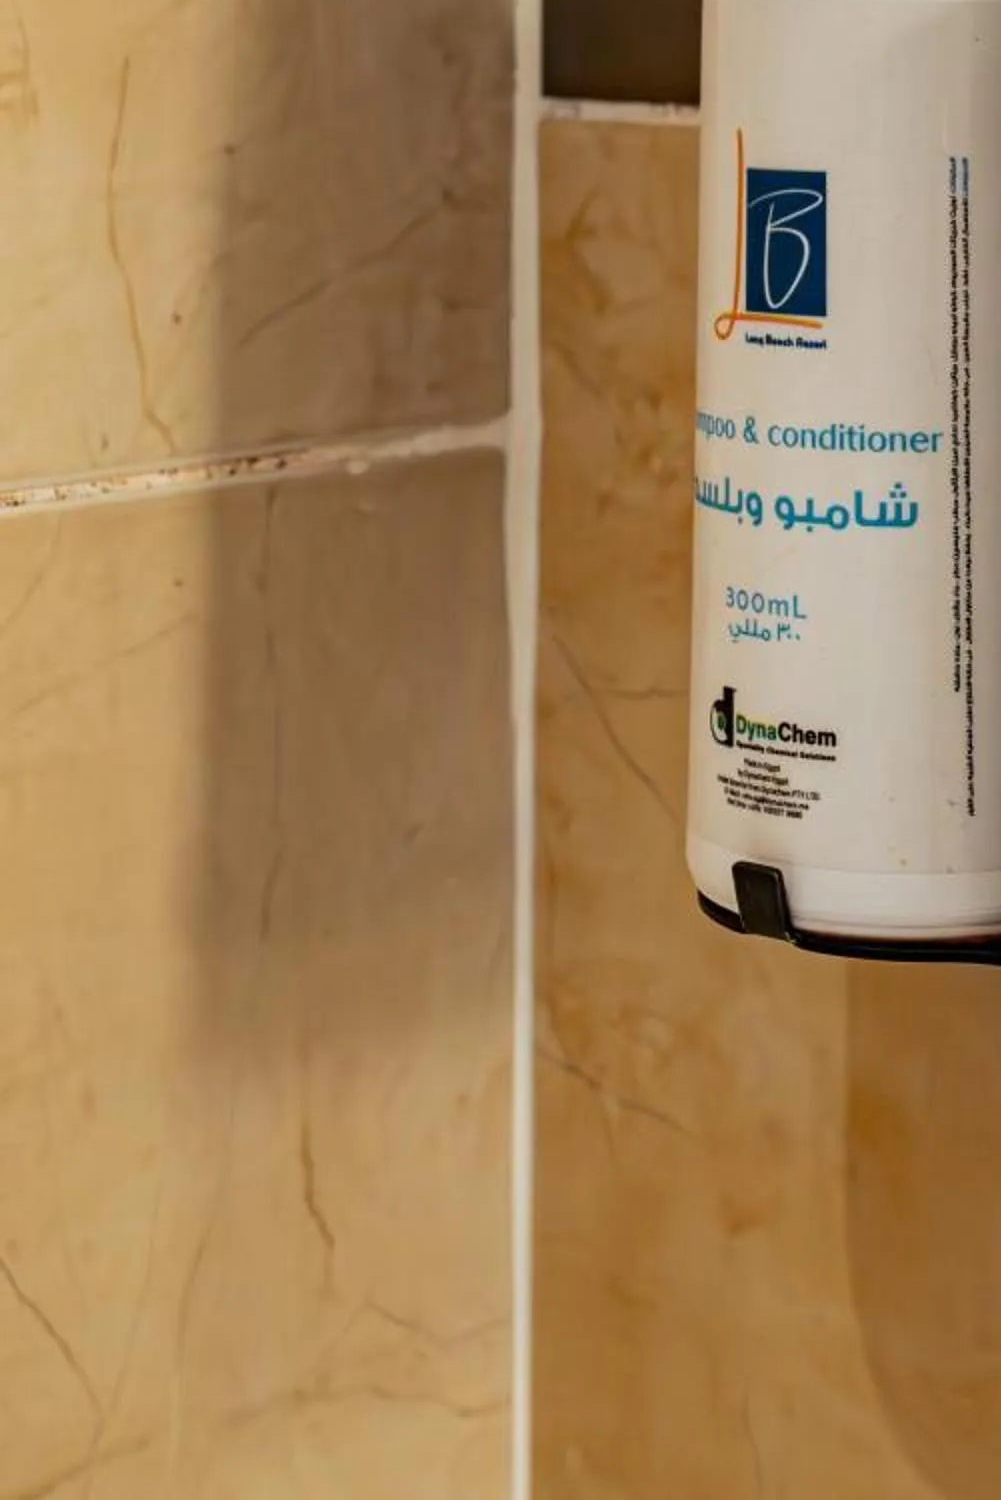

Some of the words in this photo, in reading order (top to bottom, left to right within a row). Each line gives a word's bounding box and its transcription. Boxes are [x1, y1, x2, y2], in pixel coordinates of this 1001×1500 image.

[743, 416, 759, 444] &
[767, 423, 944, 453] conditioner
[774, 482, 918, 533] شامبو
[726, 586, 807, 619] 300mL
[736, 713, 837, 748] DynaChem
